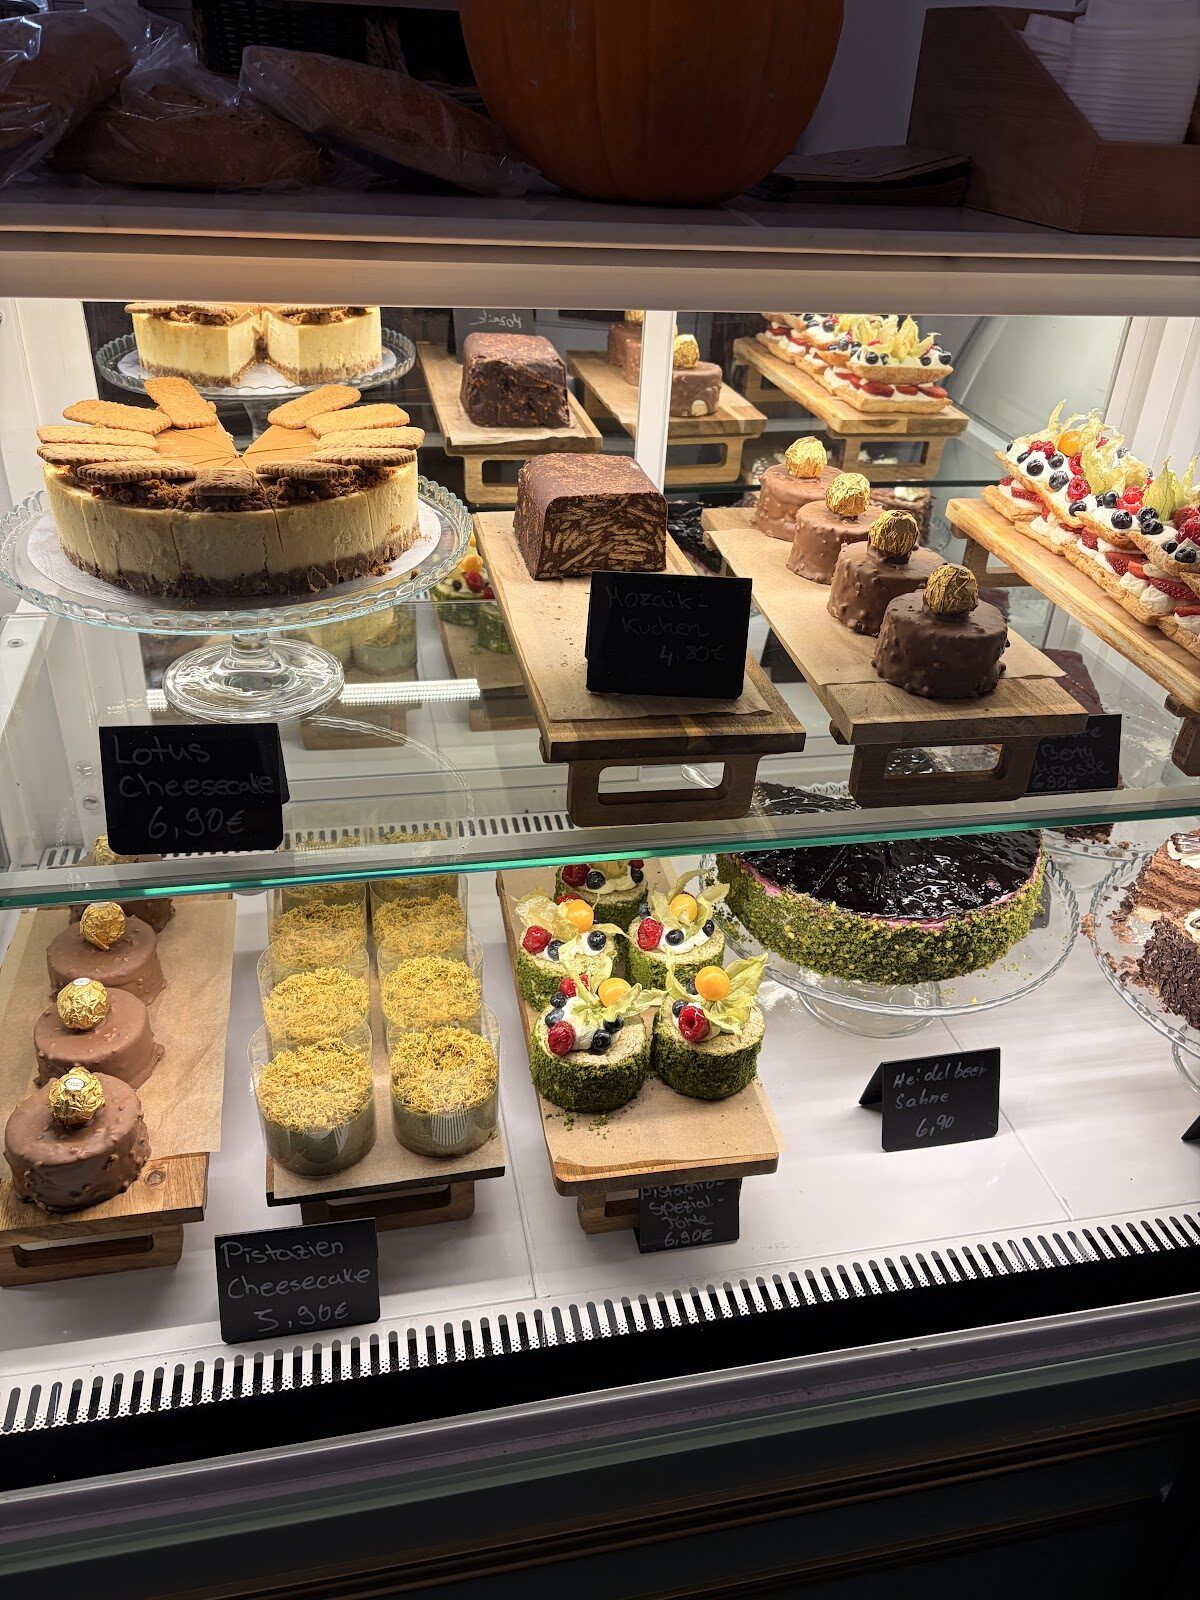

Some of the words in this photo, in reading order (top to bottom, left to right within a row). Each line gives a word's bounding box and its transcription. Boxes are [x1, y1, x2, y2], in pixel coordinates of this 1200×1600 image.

[621, 615, 710, 637] Kuchen
[113, 734, 211, 766] Lotus
[1041, 743, 1096, 764] Berry
[118, 772, 275, 798] Cheesecake
[148, 805, 246, 839] 6,90€
[895, 1088, 949, 1110] Sahne
[915, 1113, 956, 1138] 6,90
[664, 1228, 713, 1247] 6,90€
[220, 1240, 345, 1269] Pistazien
[227, 1268, 371, 1299] Cheesecake
[253, 1301, 349, 1333] 5,90€
